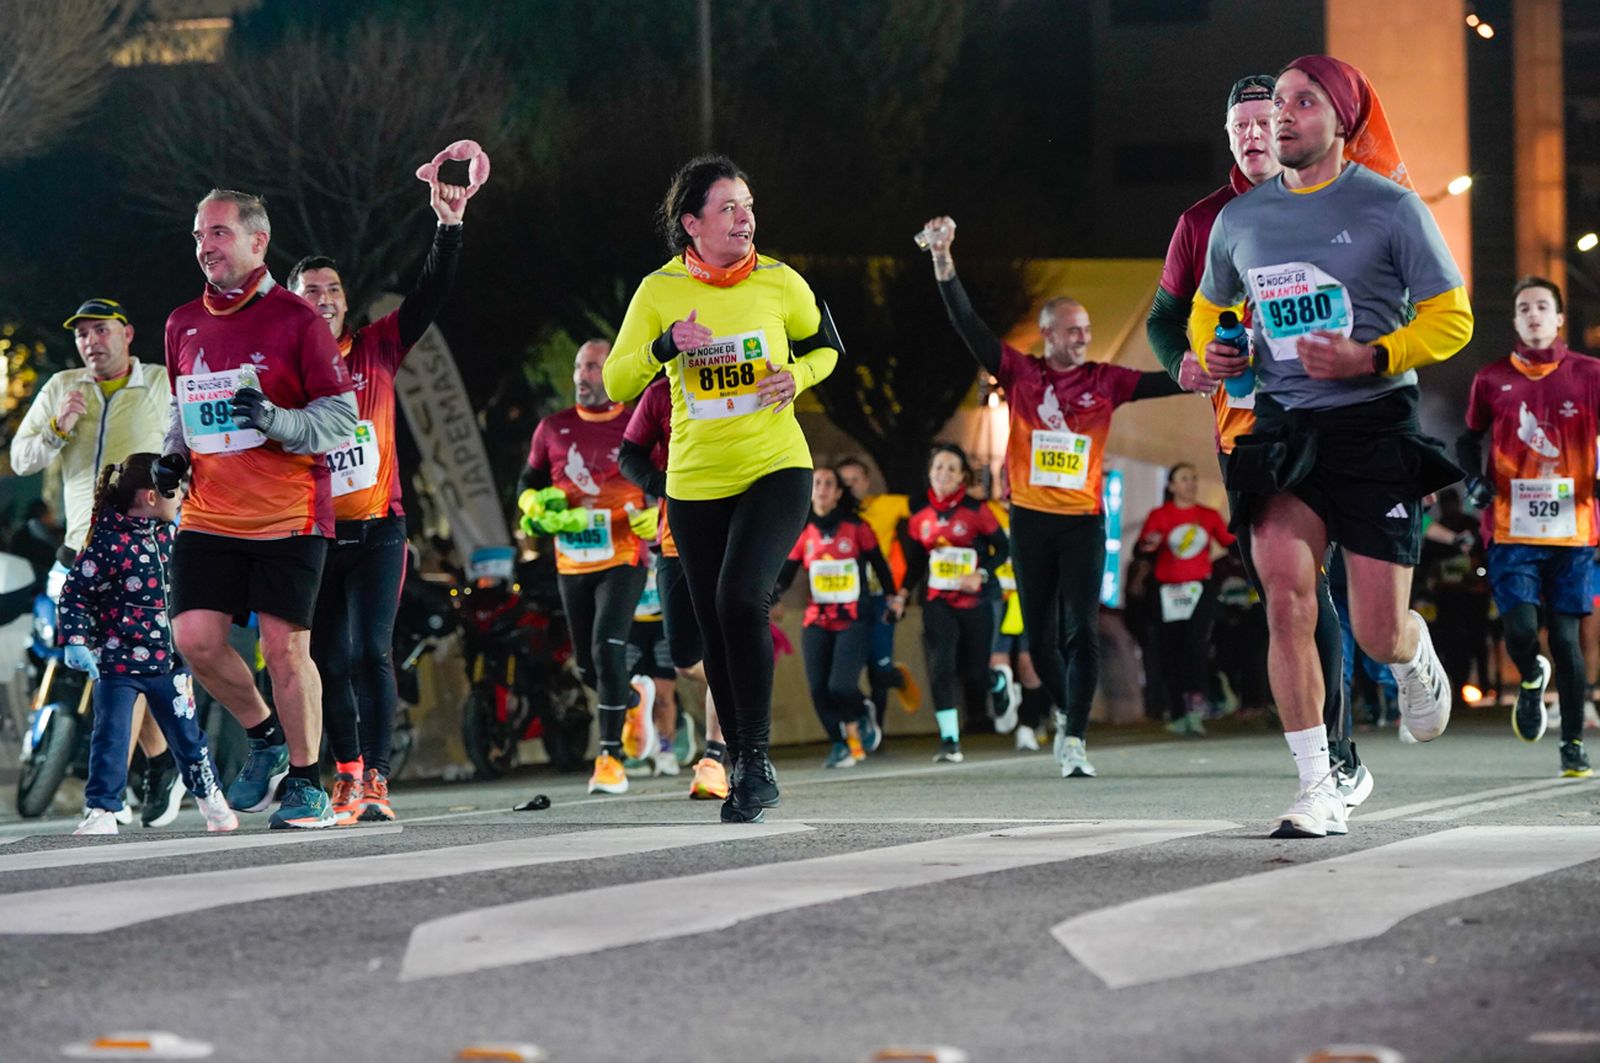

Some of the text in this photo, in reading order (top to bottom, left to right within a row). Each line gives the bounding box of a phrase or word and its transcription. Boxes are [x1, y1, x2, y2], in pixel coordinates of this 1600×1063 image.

[1266, 275, 1293, 287] NOCHE
[1295, 272, 1307, 282] DE
[1260, 282, 1309, 300] SAN ANTÓN
[1268, 292, 1333, 328] 9380
[697, 344, 736, 356] NOCHE DE
[688, 357, 706, 368] SAN
[708, 352, 737, 366] ANTÓN
[197, 382, 222, 392] NOCHE
[223, 379, 233, 389] DE
[698, 362, 755, 391] 8158
[186, 392, 206, 403] SAN
[420, 331, 492, 499] JAPEMASA
[1041, 451, 1081, 471] 13512
[1528, 500, 1561, 518] 529
